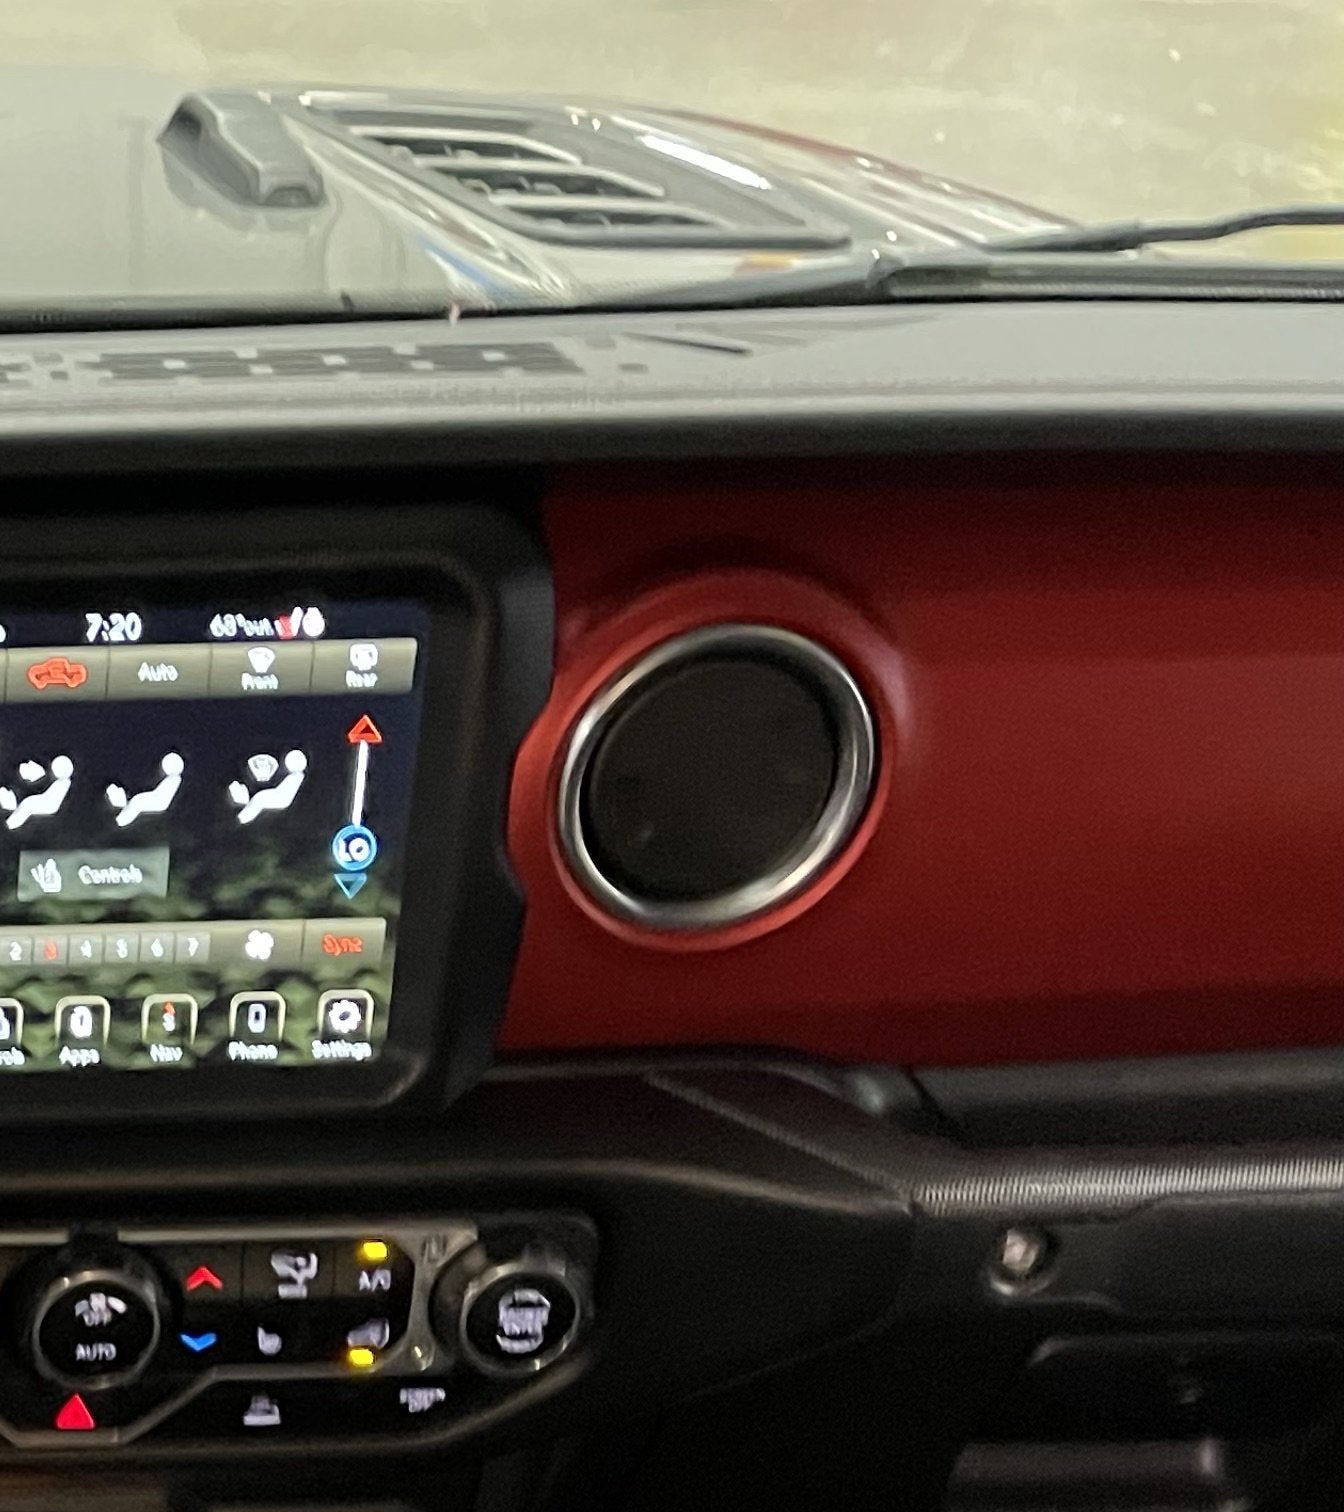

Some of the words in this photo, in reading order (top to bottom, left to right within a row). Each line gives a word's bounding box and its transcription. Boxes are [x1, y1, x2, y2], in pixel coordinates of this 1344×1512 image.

[85, 612, 142, 642] 7:20
[138, 661, 178, 682] Auto
[75, 1342, 117, 1361] AUTO
